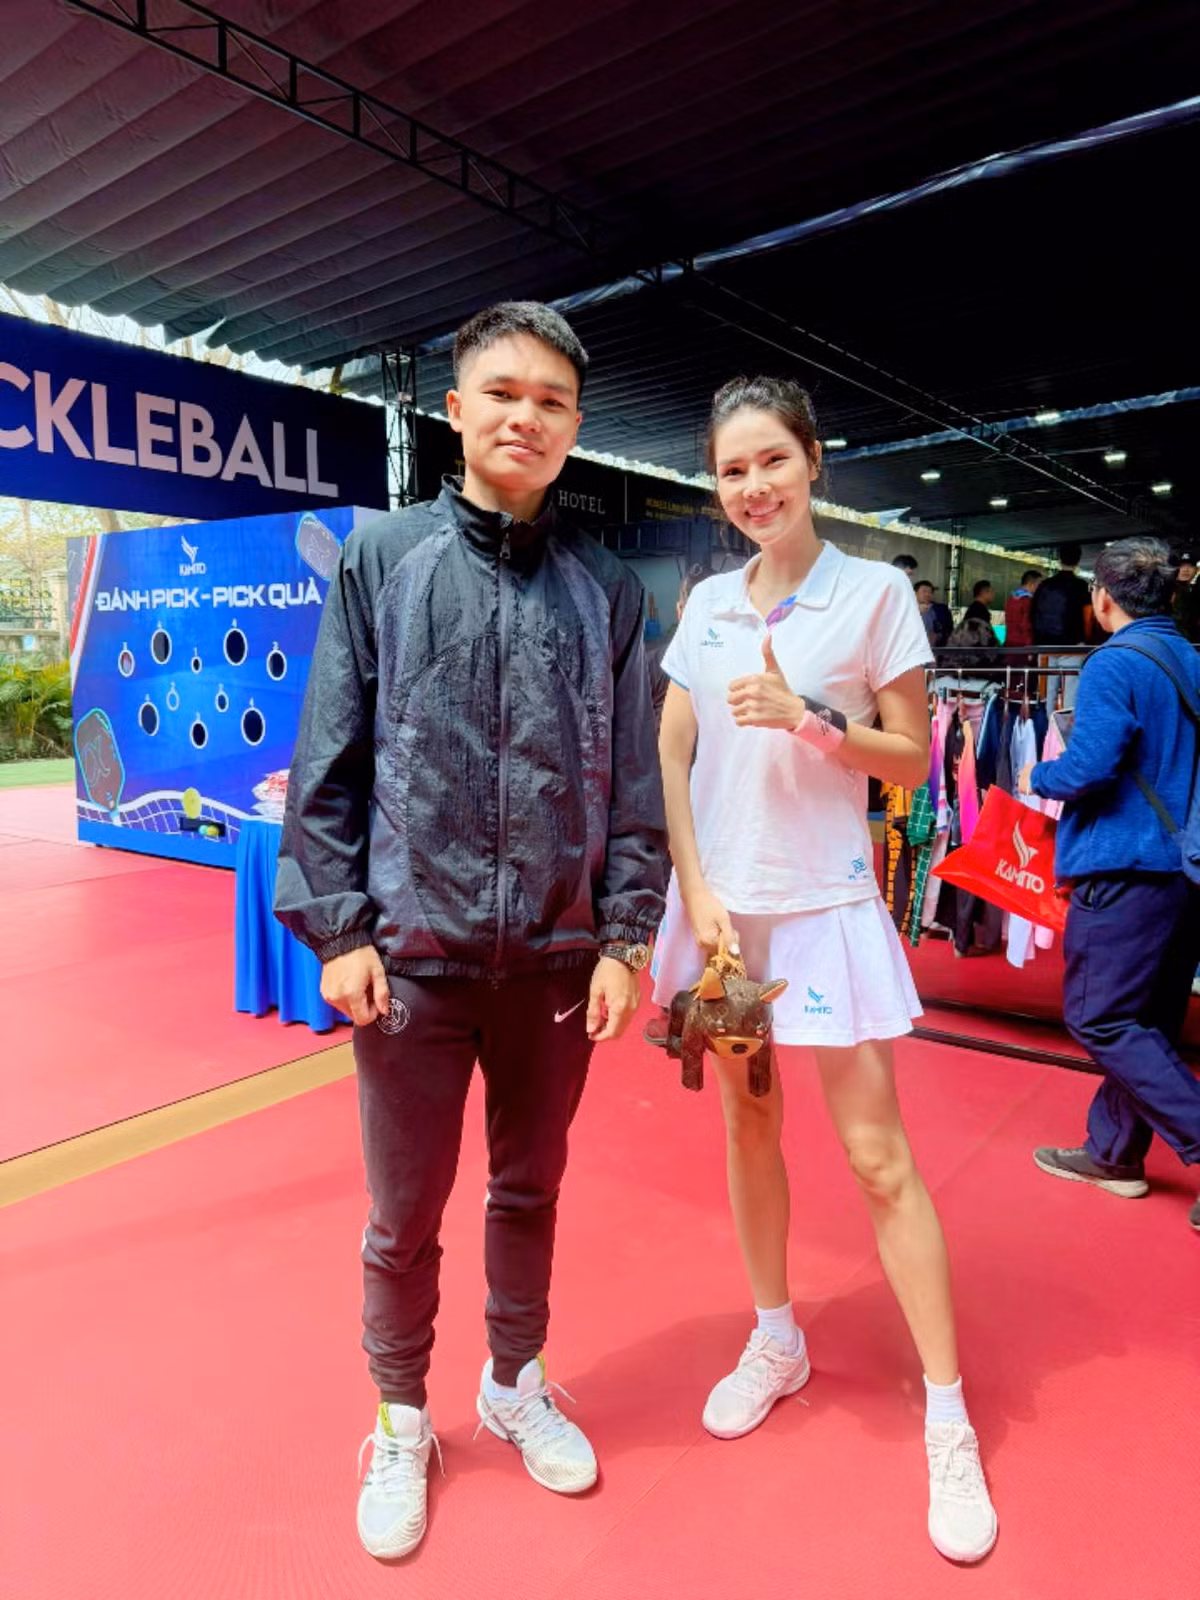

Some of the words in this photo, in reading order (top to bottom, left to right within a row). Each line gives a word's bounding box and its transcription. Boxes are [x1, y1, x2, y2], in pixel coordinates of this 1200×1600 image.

[558, 489, 606, 515] HOTEL
[95, 587, 149, 611] ĐÁNH
[152, 588, 200, 609] PICK
[213, 584, 266, 608] PICK
[268, 576, 322, 609] QUÀ
[995, 858, 1045, 894] KAMITO
